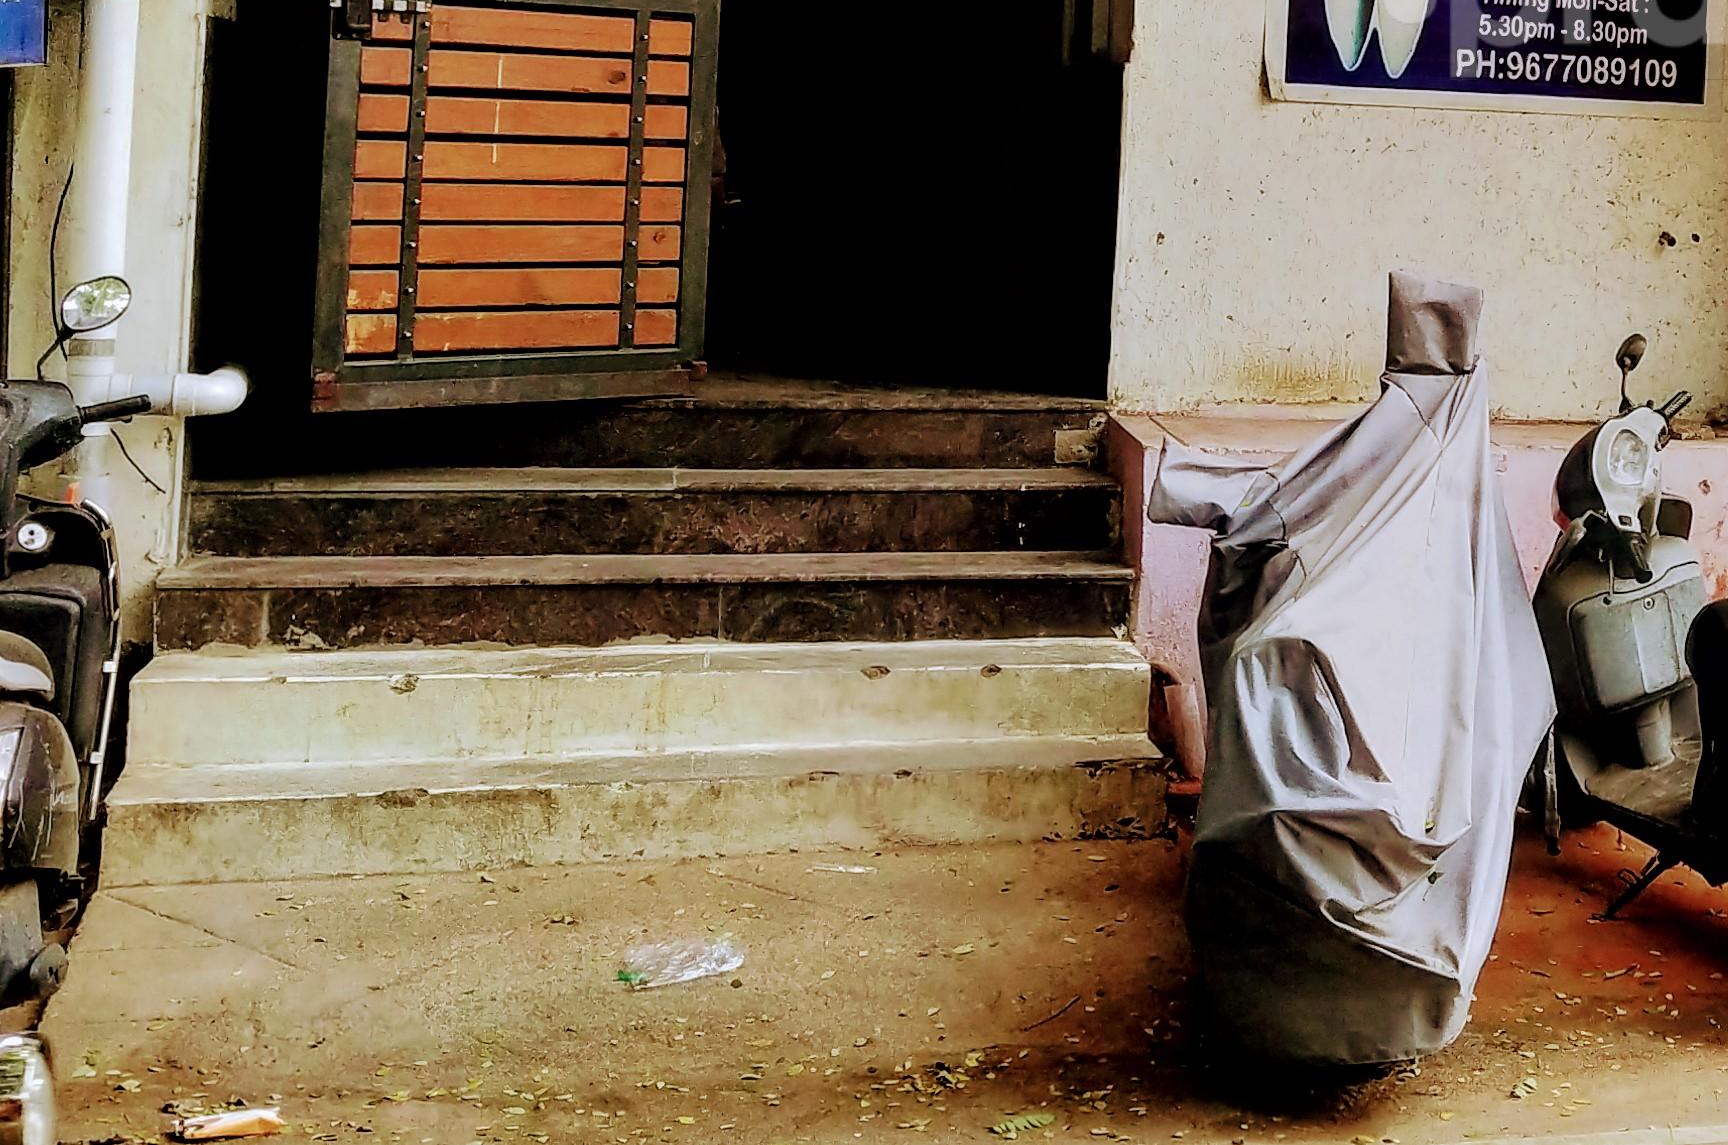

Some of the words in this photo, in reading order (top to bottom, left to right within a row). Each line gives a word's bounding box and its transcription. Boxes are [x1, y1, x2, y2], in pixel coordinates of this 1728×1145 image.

[1478, 14, 1555, 43] 5.30pm
[1573, 19, 1648, 48] 8.30pm
[1455, 48, 1678, 88] PH:9677089109
